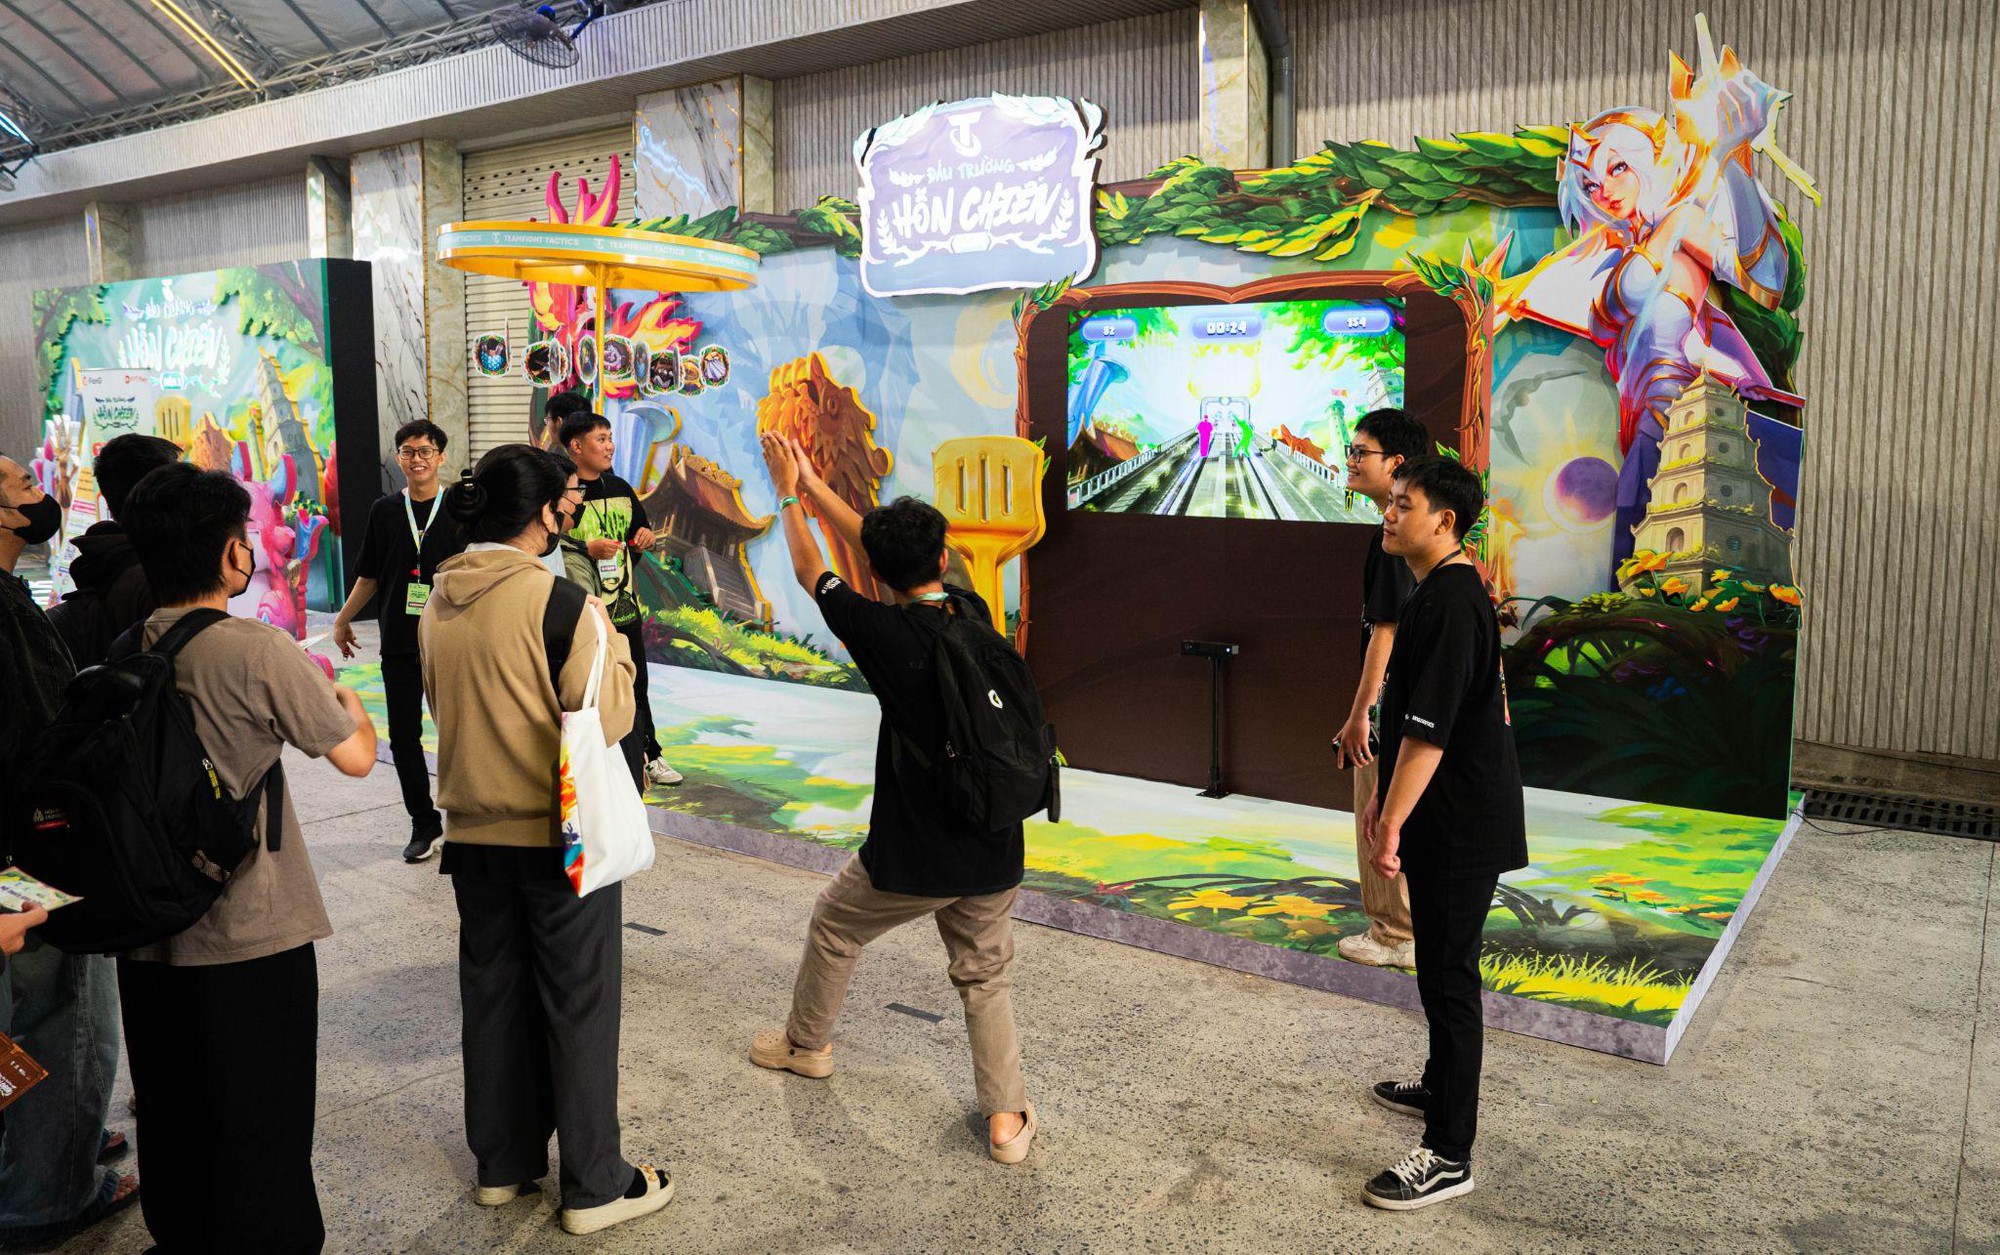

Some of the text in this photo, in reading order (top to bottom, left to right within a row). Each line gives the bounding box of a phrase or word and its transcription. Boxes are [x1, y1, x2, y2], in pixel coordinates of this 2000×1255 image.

[503, 234, 543, 244] TEAMFIGHT
[545, 236, 580, 246] TACTICS
[1206, 320, 1248, 336] 00:24
